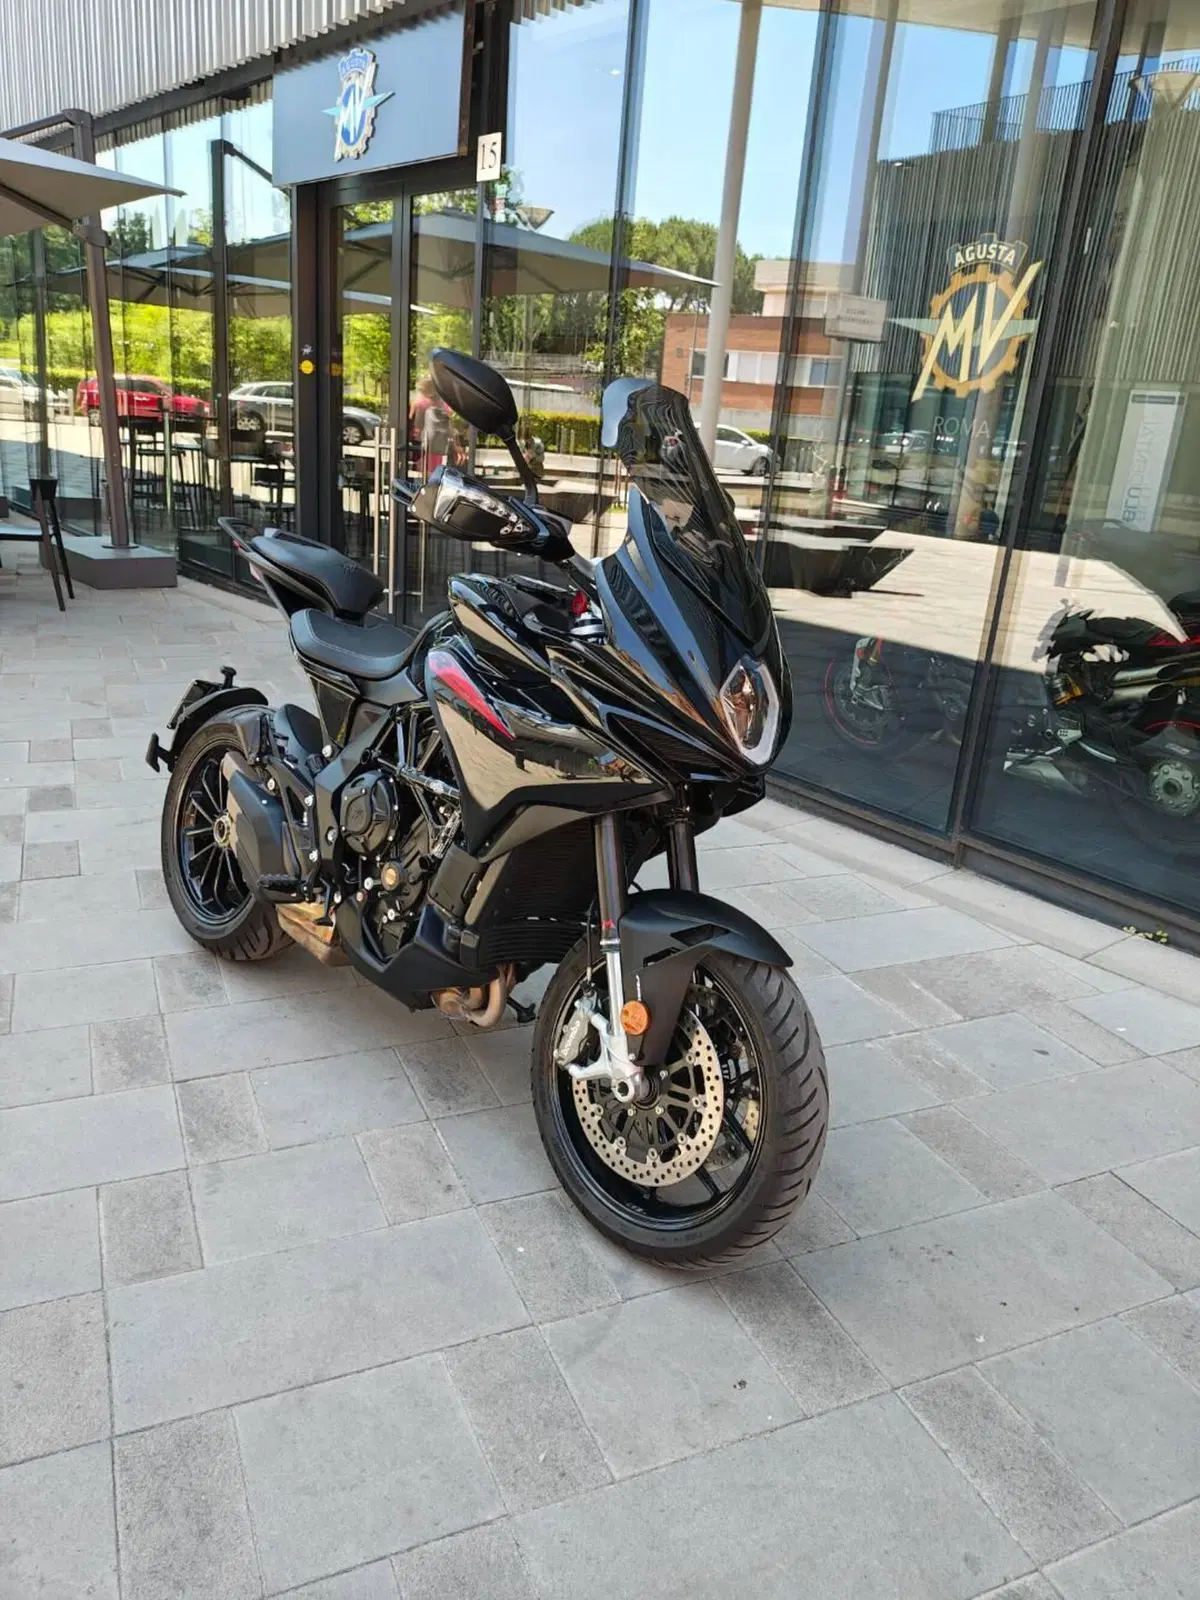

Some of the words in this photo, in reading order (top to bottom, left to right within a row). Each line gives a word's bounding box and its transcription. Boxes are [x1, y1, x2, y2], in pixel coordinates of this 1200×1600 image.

[481, 141, 497, 170] 15
[954, 243, 1016, 267] AGUSTA
[911, 261, 1043, 402] MV
[933, 416, 990, 439] ROMA
